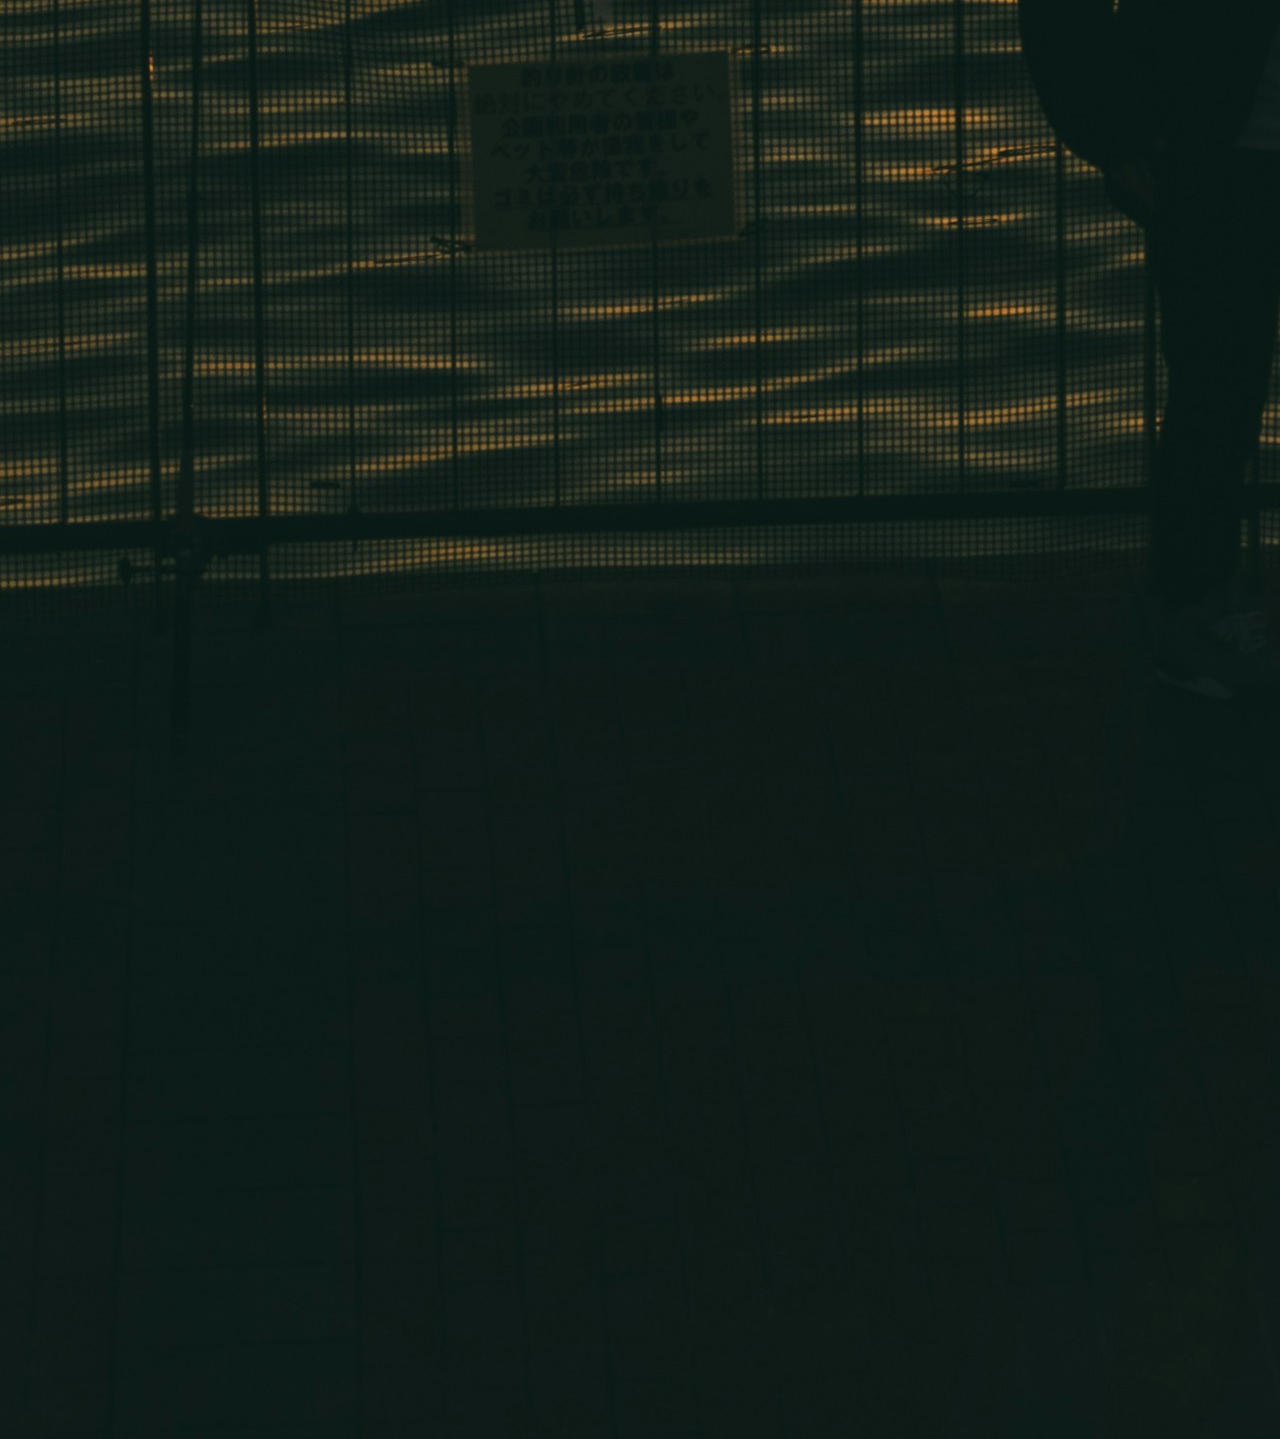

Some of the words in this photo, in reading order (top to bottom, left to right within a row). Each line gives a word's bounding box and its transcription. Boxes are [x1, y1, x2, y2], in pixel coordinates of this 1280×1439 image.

[501, 109, 699, 138] 公利用者のや
